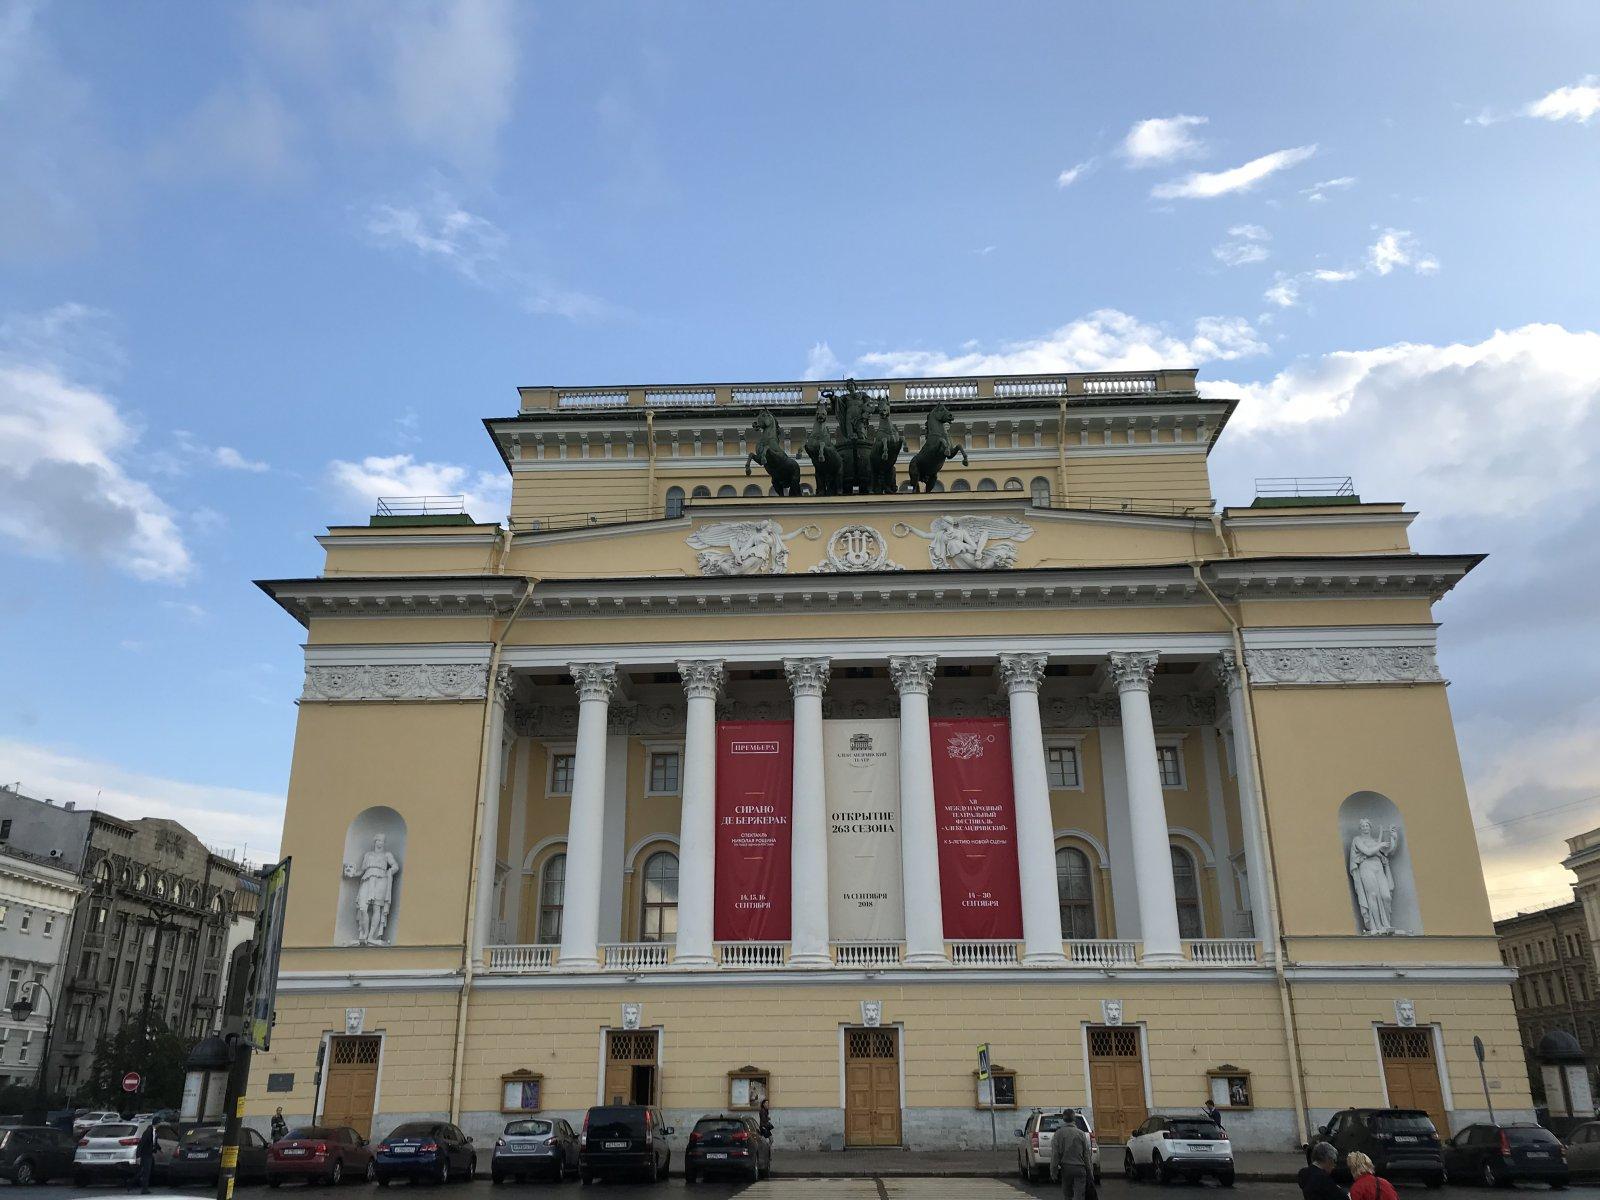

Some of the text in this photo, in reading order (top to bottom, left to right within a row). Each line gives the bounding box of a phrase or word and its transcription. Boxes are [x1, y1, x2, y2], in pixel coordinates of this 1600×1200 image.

[735, 805, 774, 814] СИРАНО
[721, 816, 787, 826] ДЕ БЕРЖЕРАК
[832, 812, 895, 821] ОТКРЫТИЕ
[832, 824, 895, 833] 263 СЕЗОНА
